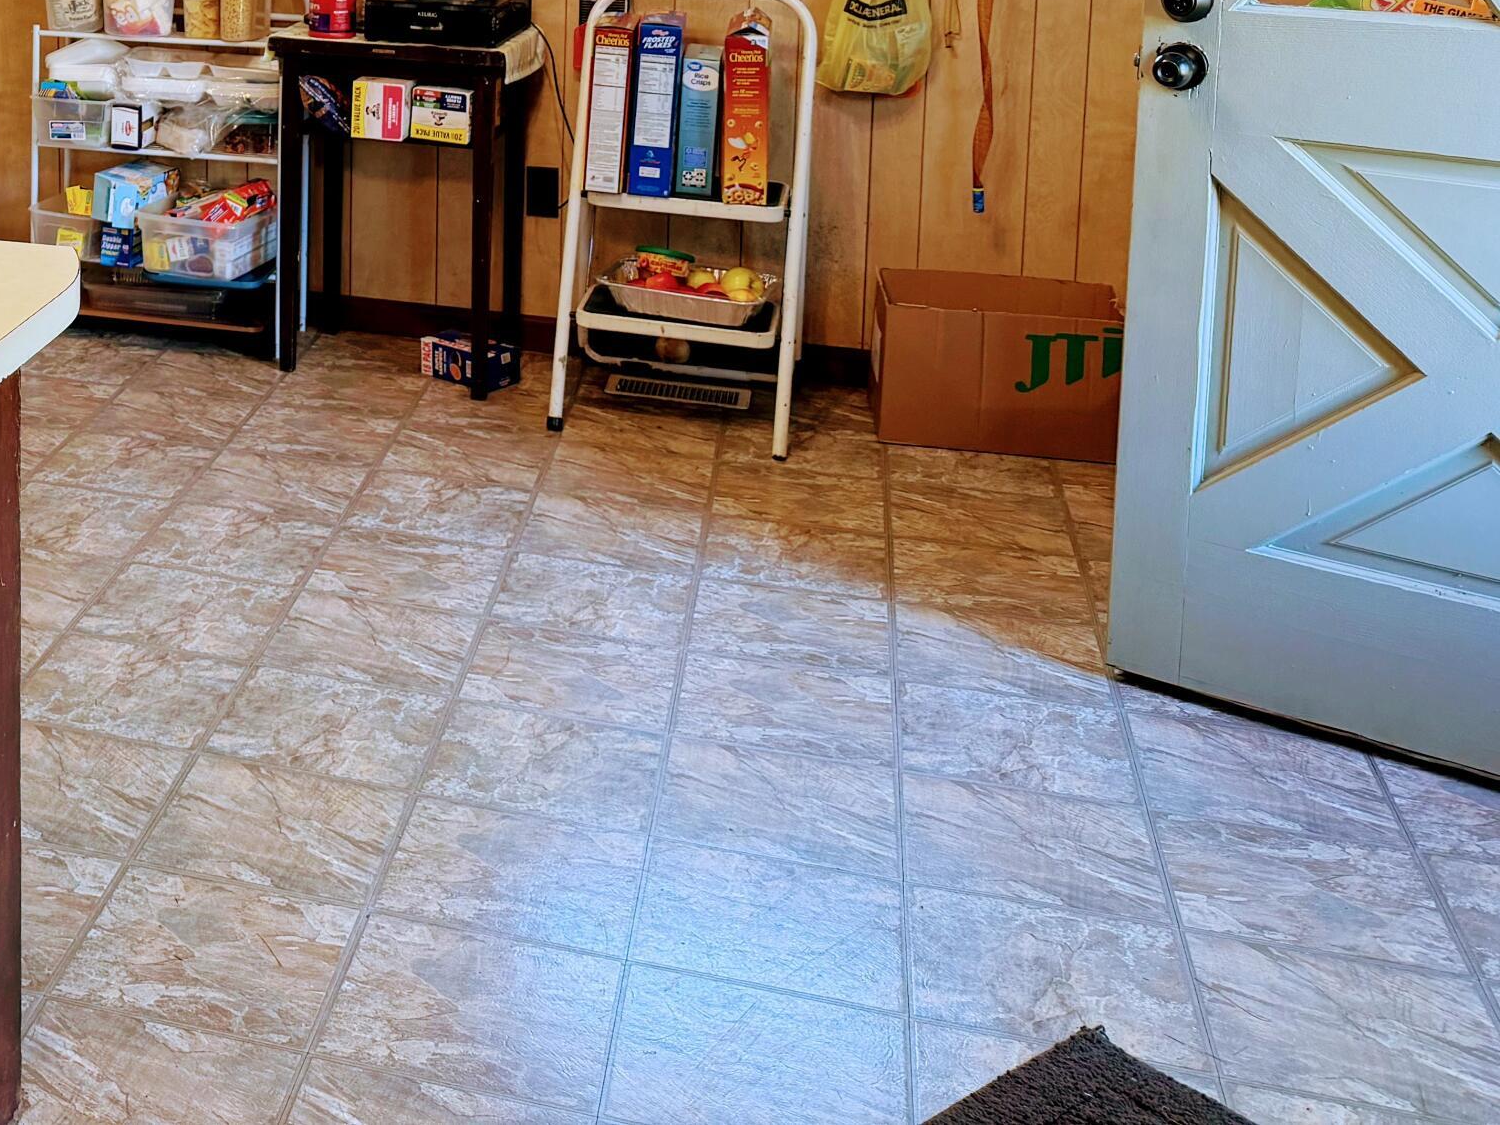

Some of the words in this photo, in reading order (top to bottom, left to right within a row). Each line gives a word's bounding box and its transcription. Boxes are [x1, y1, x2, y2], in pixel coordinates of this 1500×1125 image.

[1423, 2, 1445, 15] THE
[596, 35, 630, 46] Cheerios
[642, 36, 676, 44] FROSTED
[729, 53, 764, 63] Cheerios
[690, 78, 711, 87] Crisps
[433, 130, 450, 139] VALUE
